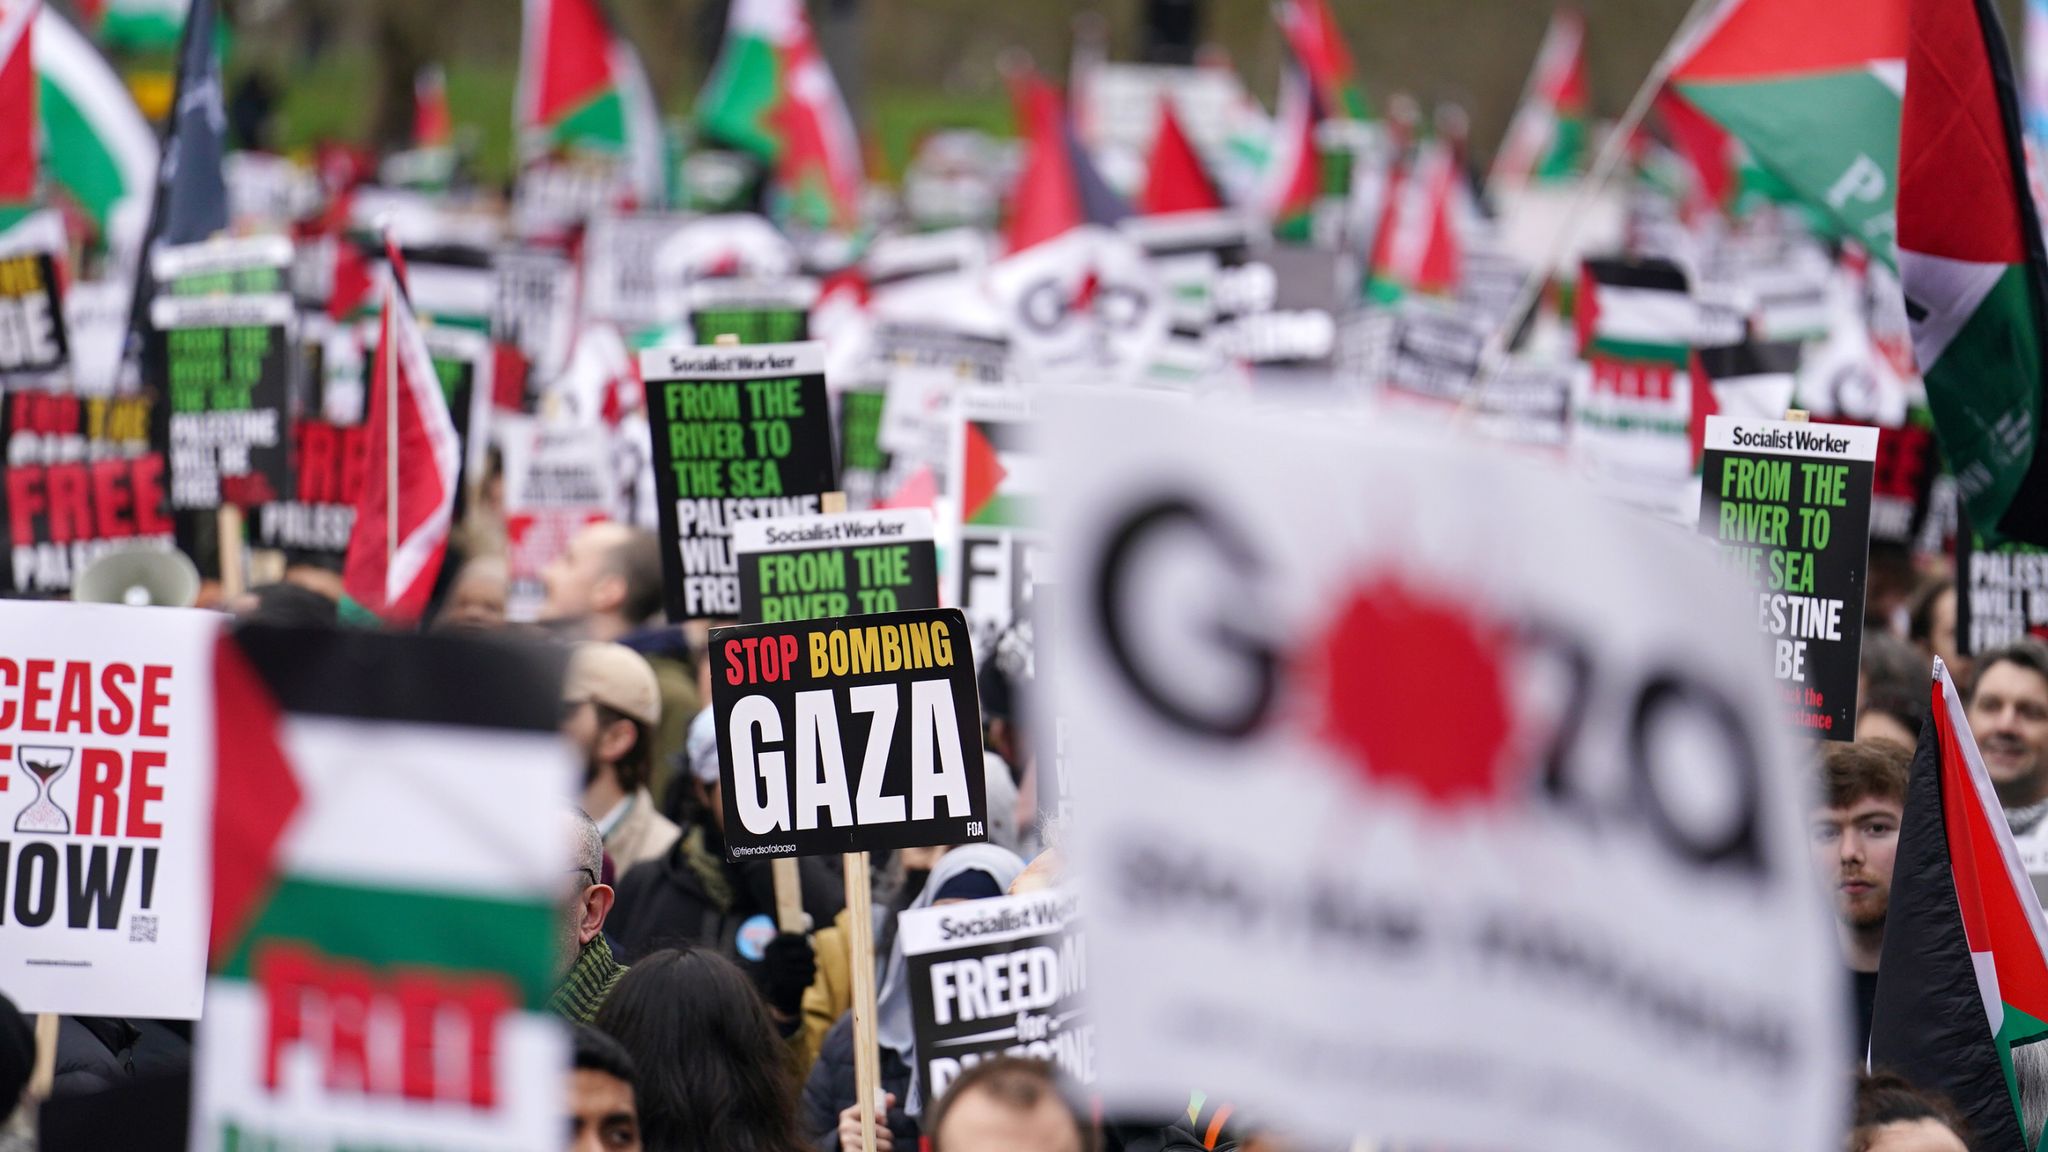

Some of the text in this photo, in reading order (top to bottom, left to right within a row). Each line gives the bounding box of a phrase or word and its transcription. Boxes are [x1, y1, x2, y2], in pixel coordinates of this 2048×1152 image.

[670, 356, 796, 372] Socialist Worker
[663, 379, 804, 420] FROM THE
[668, 420, 792, 458] RIVER TO
[1733, 426, 1850, 454] Socialist Worker
[671, 459, 783, 497] THE SEA
[1721, 456, 1849, 507] FROM THE
[6, 452, 176, 546] FREE
[766, 520, 905, 545] Socialist Worker
[1719, 501, 1789, 547] RIVER
[1799, 508, 1831, 551] TO
[679, 537, 740, 576] WIL
[758, 551, 846, 595] FROM
[853, 546, 912, 588] THE
[1768, 549, 1814, 594] SEA
[684, 576, 742, 616] FRE
[761, 588, 898, 625] RIVER TO
[1759, 592, 1844, 642] ESTINE
[724, 620, 954, 687] STOP BOMBING
[1775, 639, 1807, 683] BE
[1804, 687, 1825, 708] the
[729, 678, 972, 836] GAZA
[966, 821, 984, 837] FOA
[732, 843, 797, 858] @friendsofalaqsa
[0, 841, 159, 931] OW!
[940, 909, 1031, 942] Socialist
[1015, 1009, 1050, 1044] for
